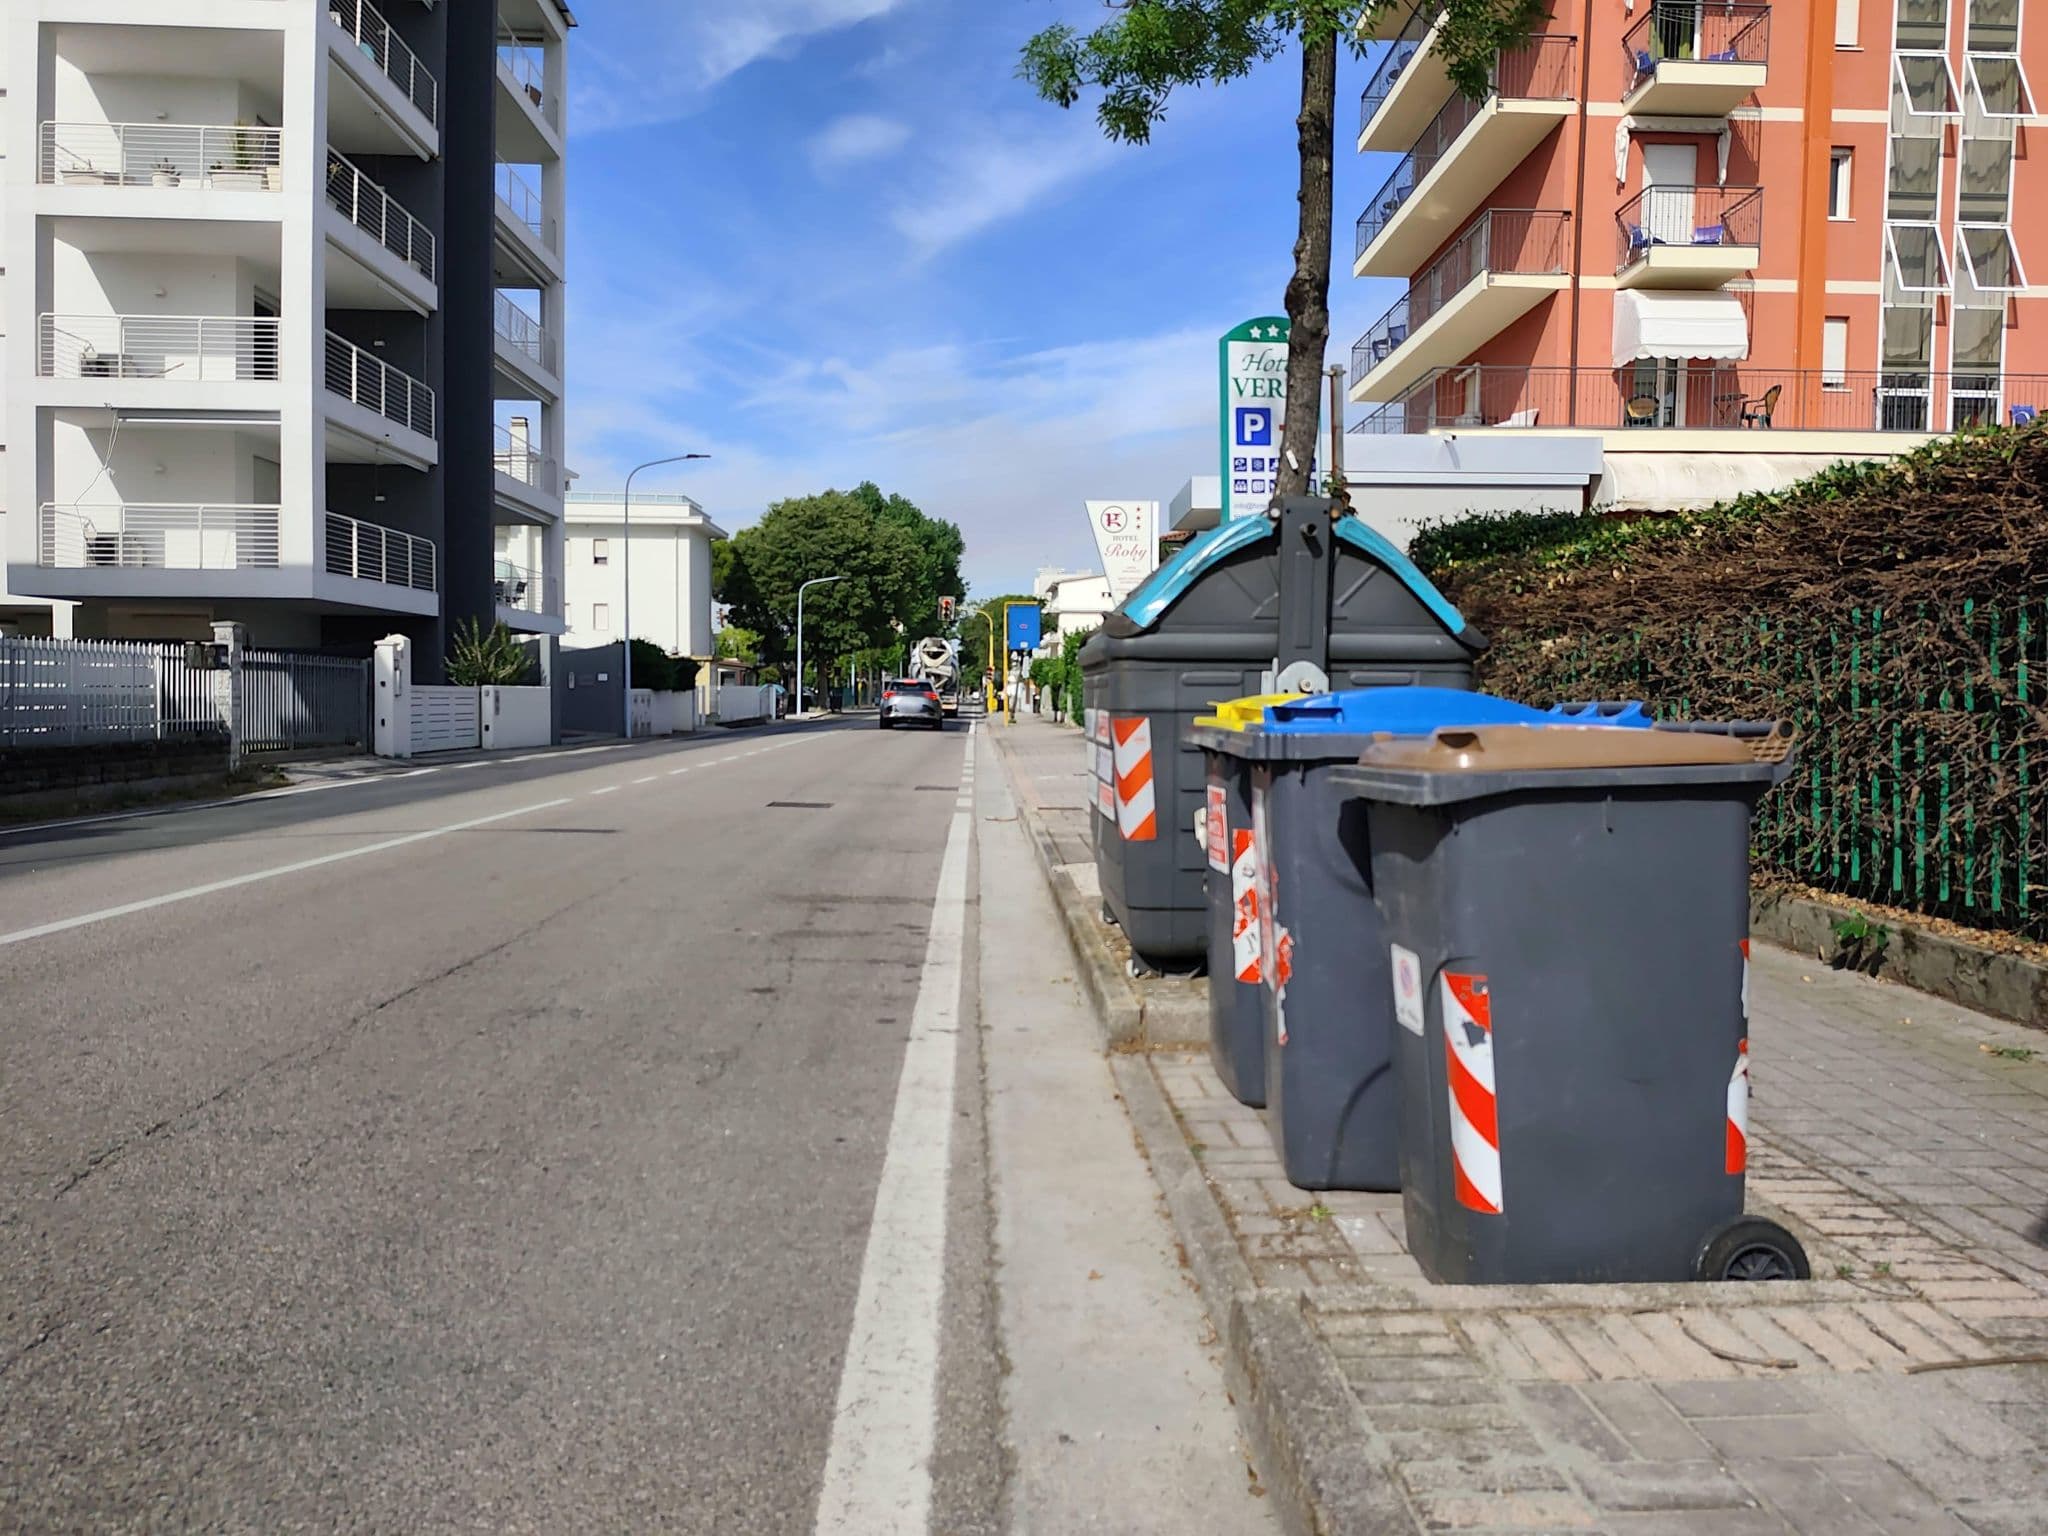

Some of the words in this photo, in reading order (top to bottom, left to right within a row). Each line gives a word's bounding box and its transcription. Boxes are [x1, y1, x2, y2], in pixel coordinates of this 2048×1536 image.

[1232, 377, 1286, 398] VER
[1243, 413, 1265, 442] P
[1104, 543, 1148, 562] Roby
